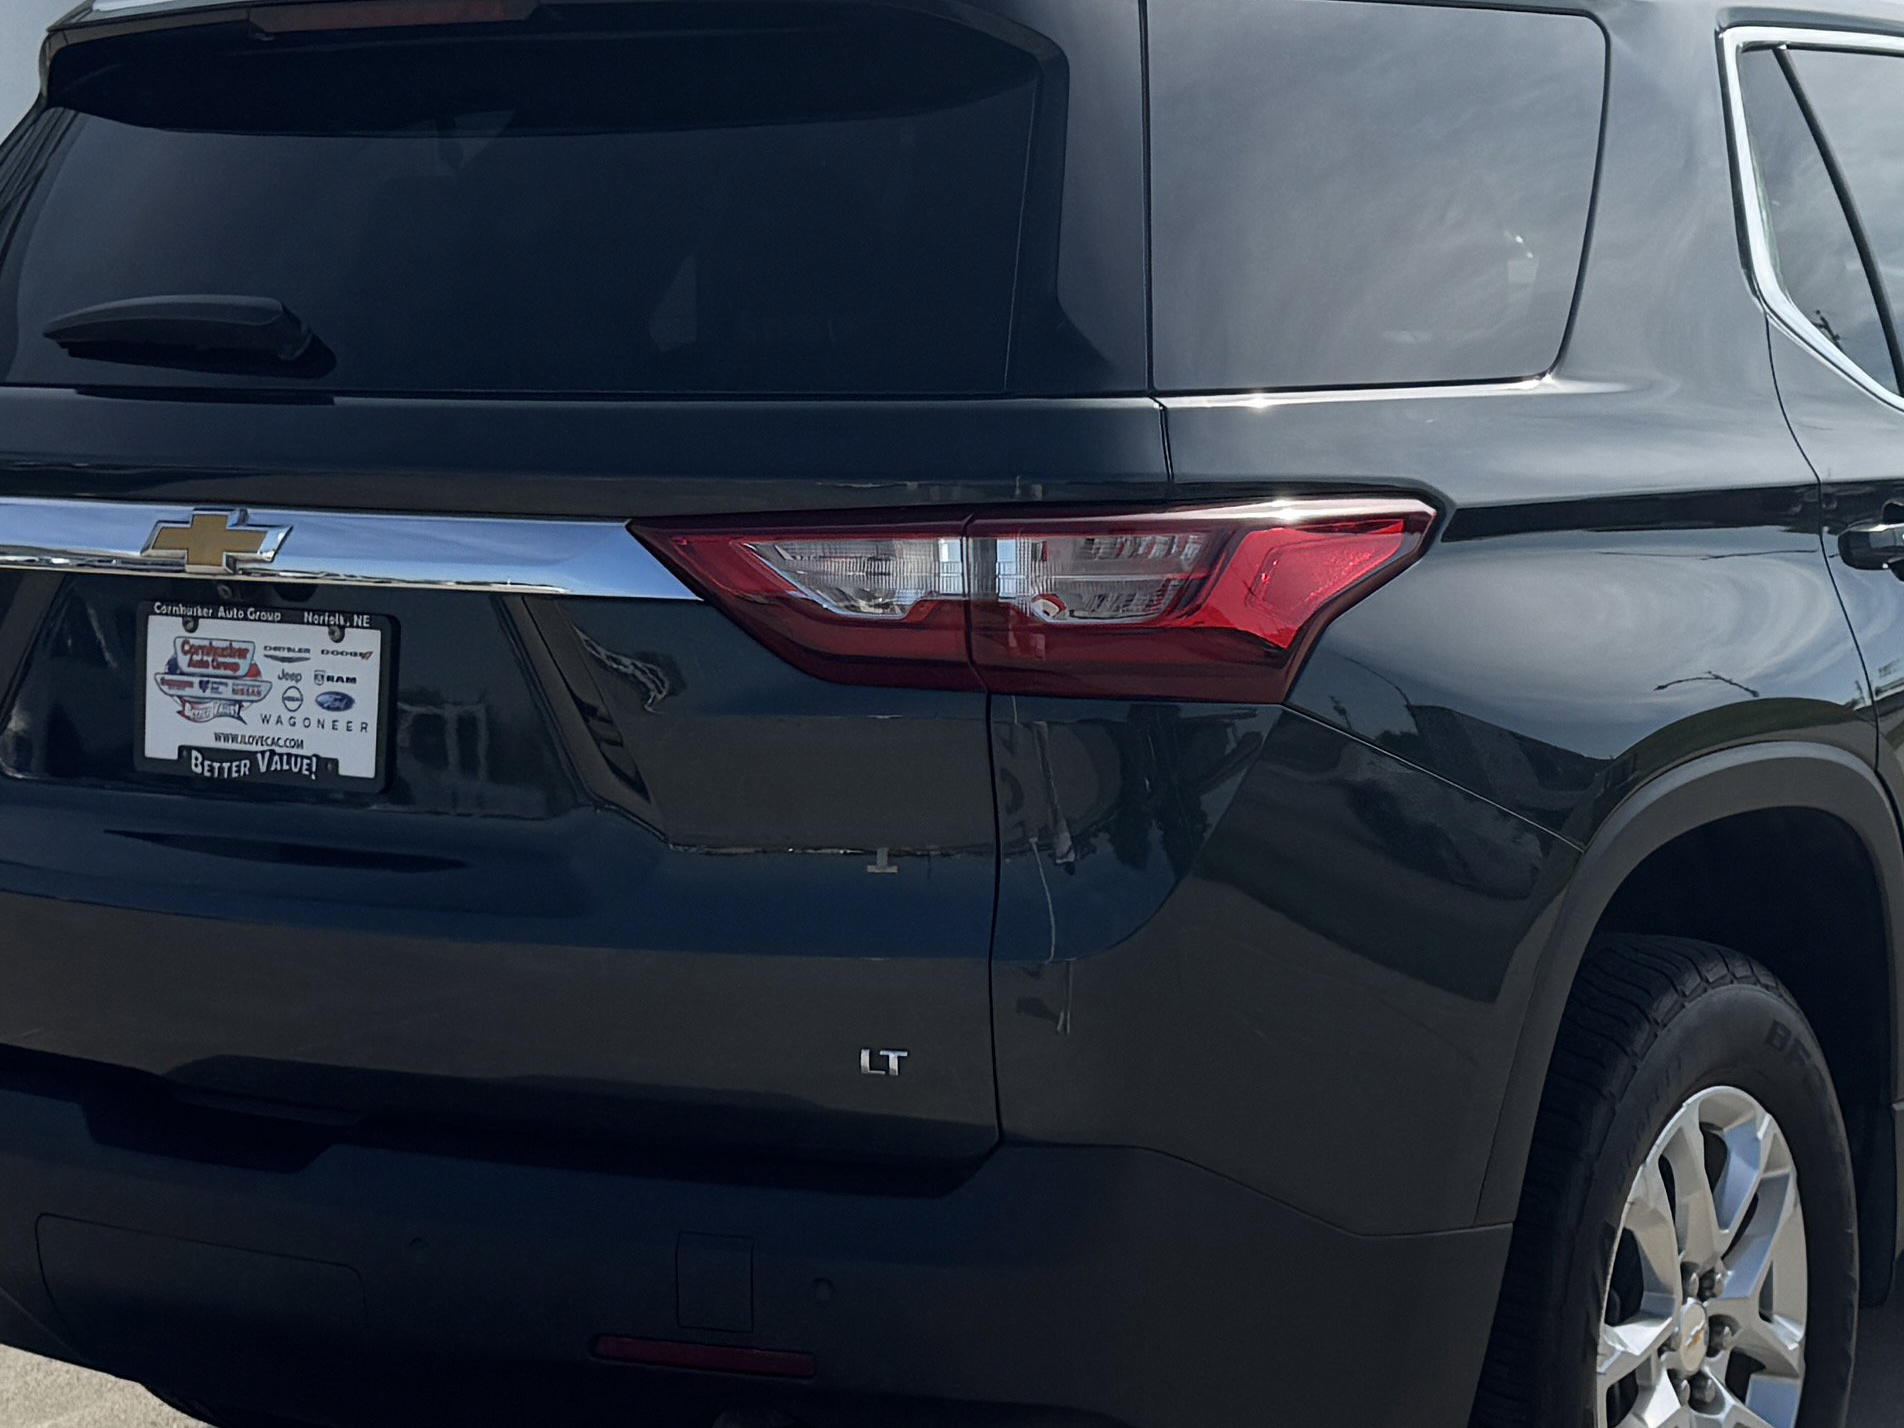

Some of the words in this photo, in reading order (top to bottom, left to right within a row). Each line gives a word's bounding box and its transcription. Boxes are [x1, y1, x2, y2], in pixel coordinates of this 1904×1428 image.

[218, 606, 244, 618] Auto
[247, 608, 281, 622] Group
[354, 614, 370, 627] NE
[278, 668, 302, 684] Jeep
[326, 675, 357, 684] RAM
[260, 713, 369, 733] WAGONEER
[860, 1049, 908, 1077] LT
